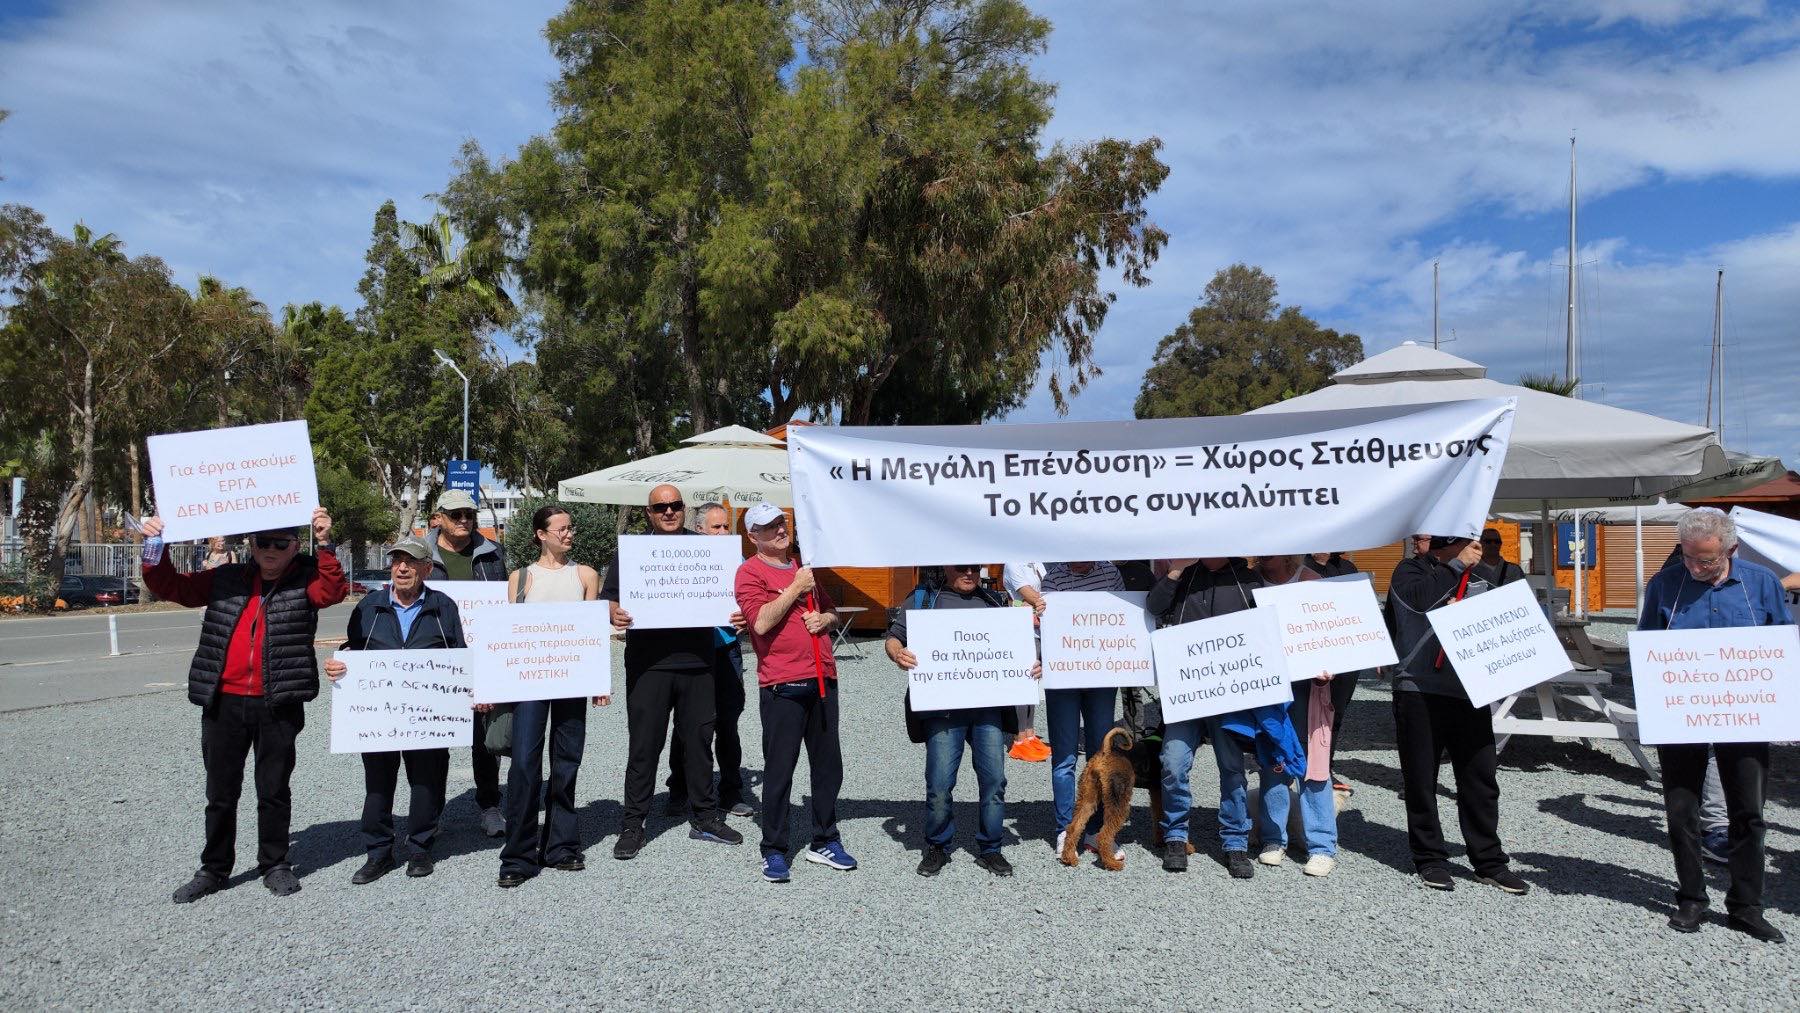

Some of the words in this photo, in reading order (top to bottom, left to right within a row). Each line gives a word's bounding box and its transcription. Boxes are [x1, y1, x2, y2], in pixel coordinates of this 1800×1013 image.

[169, 463, 194, 478] Για
[199, 459, 236, 478] έργα
[240, 453, 297, 471] ακούμε
[881, 454, 995, 485] Μεγάλη
[1004, 449, 1167, 478] Επένδυση»
[1202, 444, 1303, 474] Χώρος
[1311, 434, 1493, 468] Στάθμευσης
[219, 478, 257, 492] ΕΡΓΑ
[177, 503, 209, 518] ΔΕΝ
[214, 492, 301, 514] ΒΛΕΠΟΥΜΕ
[984, 493, 1020, 517] Το
[1030, 489, 1138, 521] Κράτος
[1146, 483, 1340, 516] συγκαλύπτει
[661, 549, 711, 559] 10,000,000
[639, 563, 676, 573] κρατικά
[677, 562, 707, 571] έσοδα
[644, 578, 656, 587] γη
[658, 576, 690, 586] φιλέτο
[692, 576, 719, 585] ΔΩΡΟ
[629, 590, 644, 599] Με
[647, 589, 685, 600] μυστική
[687, 588, 735, 599] συμφωνία
[1301, 601, 1337, 614] Ποιος
[511, 622, 576, 634] Ξεπούλημα
[1072, 613, 1126, 627] ΚΥΠΡΟΣ
[1287, 622, 1303, 635] θα
[1305, 615, 1363, 632] πληρώσει
[1452, 606, 1530, 642] ΠΑΓΙΔΕΥΜΕΝΟΙ
[487, 640, 537, 652] κρατικής
[539, 635, 602, 649] περιουσίας
[954, 630, 991, 643] Ποιος
[1062, 634, 1096, 651] Νησί
[1098, 634, 1137, 652] χωρίς
[1186, 632, 1247, 658] ΚΥΠΡΟΣ
[1297, 636, 1355, 653] επένδυση
[1356, 630, 1386, 643] τους;
[1456, 649, 1476, 662] Με
[1476, 637, 1500, 654] 44%
[1500, 623, 1546, 645] Αυξήσεις
[506, 656, 520, 667] με
[523, 652, 581, 664] συμφωνία
[931, 649, 949, 662] θα
[952, 648, 1014, 663] πληρώσει
[1485, 647, 1537, 676] χρεώσεων
[1647, 647, 1701, 665] Λιμάνι
[1720, 645, 1785, 662] Μαρίνα
[1048, 657, 1103, 673] ναυτικό
[1105, 656, 1150, 675] όραμα
[1179, 660, 1216, 682] Νησί
[1218, 653, 1264, 677] χωρίς
[518, 668, 569, 681] ΜΥΣΤΙΚΗ
[913, 672, 934, 684] την
[937, 667, 999, 682] επένδυση
[1662, 667, 1720, 684] Φιλέτο
[1726, 668, 1774, 683] ΔΩΡΟ
[1168, 682, 1227, 706] ναυτικό
[1230, 673, 1282, 697] όραμα
[1665, 694, 1685, 710] με
[1691, 689, 1777, 708] συμφωνία
[1686, 712, 1761, 728] ΜΥΣΤΙΚΗ
